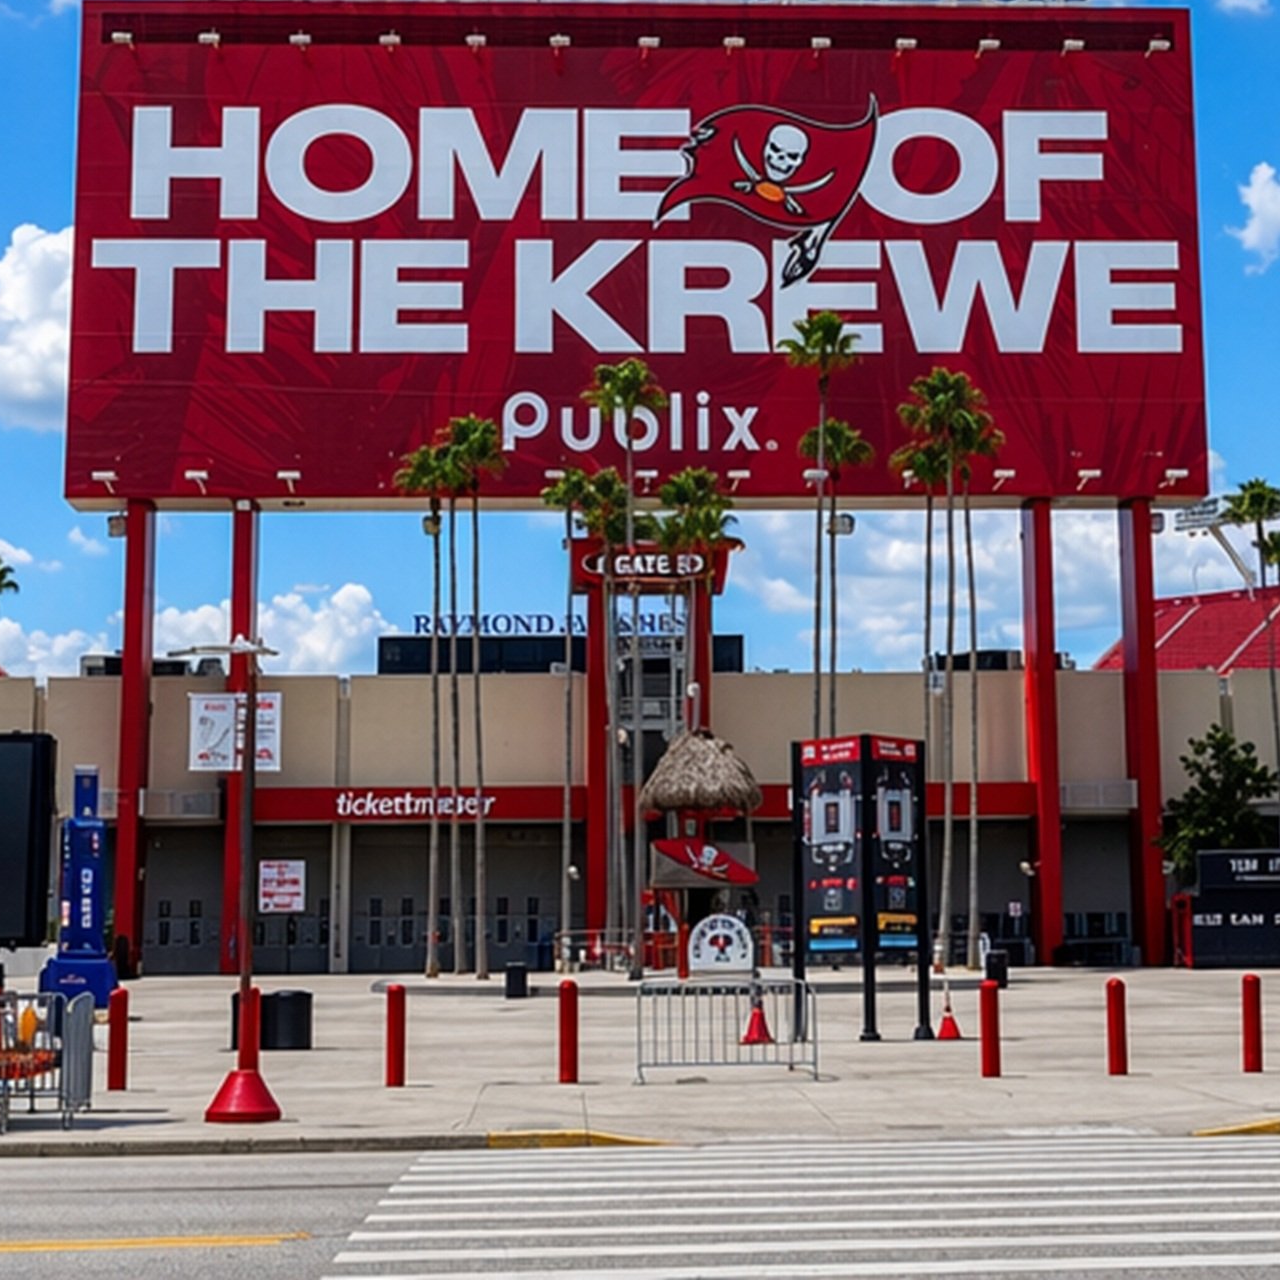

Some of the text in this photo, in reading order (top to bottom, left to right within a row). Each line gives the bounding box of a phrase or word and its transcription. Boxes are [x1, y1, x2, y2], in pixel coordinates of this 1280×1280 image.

[129, 103, 1109, 224] HOME OF
[91, 238, 1184, 354] THE KREWE
